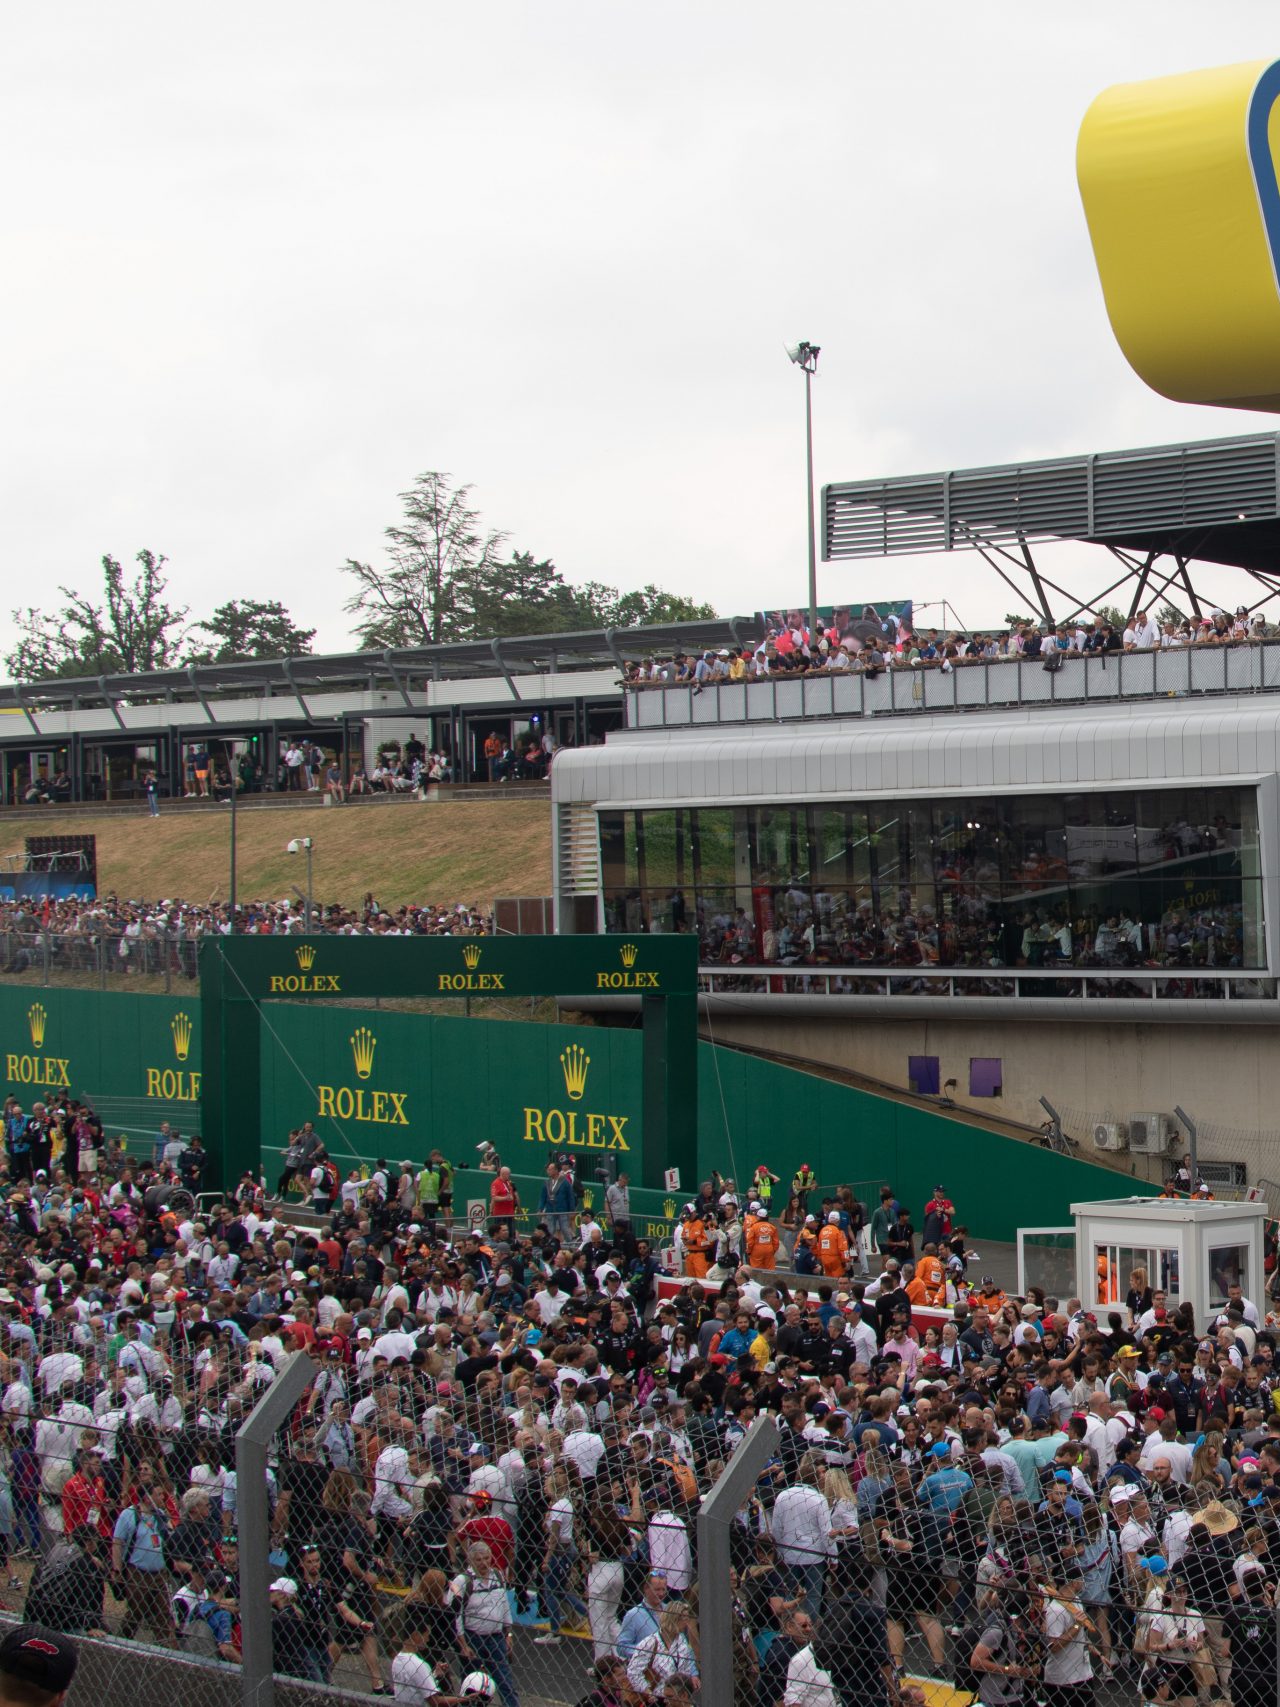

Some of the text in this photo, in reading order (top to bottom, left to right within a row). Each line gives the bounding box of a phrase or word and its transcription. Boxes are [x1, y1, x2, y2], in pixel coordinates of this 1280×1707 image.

[271, 975, 340, 992] ROLEX
[438, 974, 505, 990] ROLEX
[597, 972, 659, 988] ROLEX
[6, 1054, 71, 1087] ROLEX
[146, 1068, 202, 1101] ROLE
[318, 1085, 409, 1126] ROLEX
[523, 1107, 630, 1151] ROLEX
[647, 1222, 671, 1238] ROL
